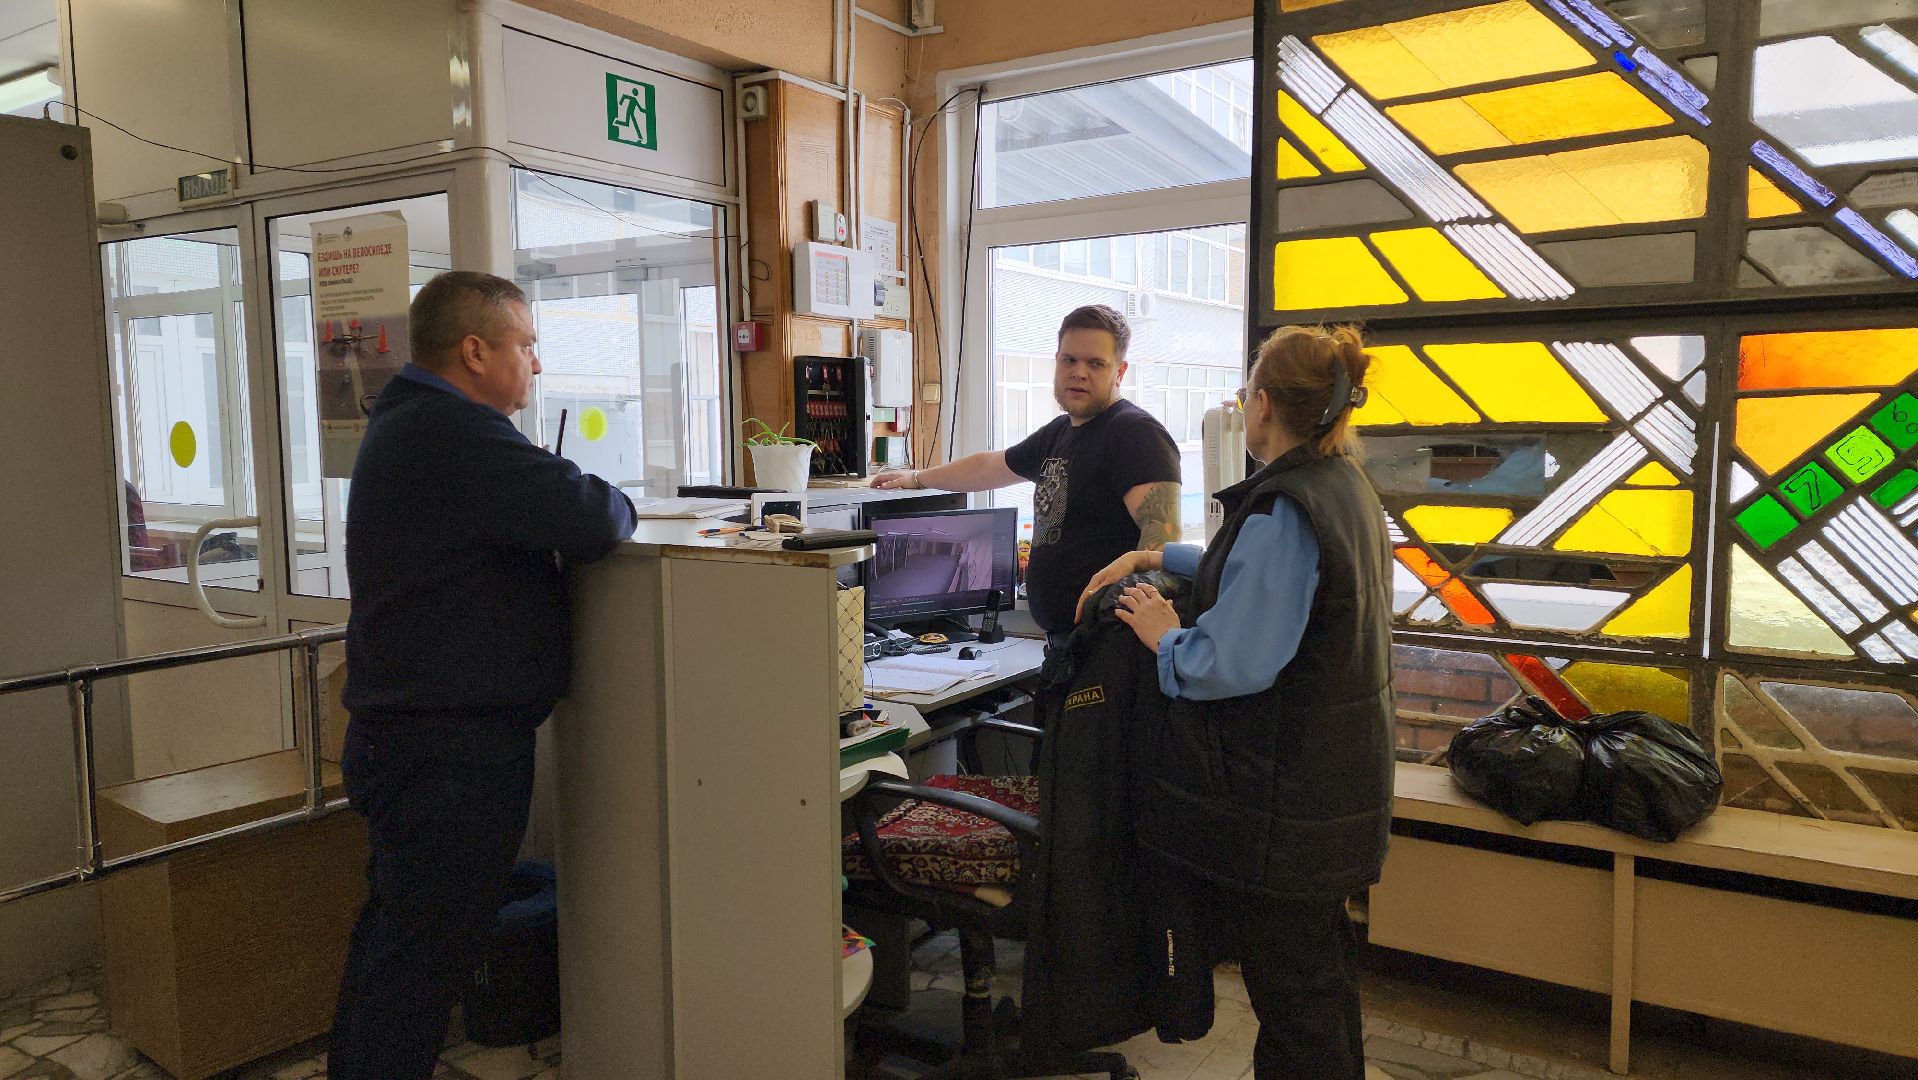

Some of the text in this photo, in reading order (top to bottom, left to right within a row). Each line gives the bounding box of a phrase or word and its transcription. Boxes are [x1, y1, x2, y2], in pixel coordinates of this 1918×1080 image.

[183, 173, 226, 199] ВЫХОД
[317, 243, 392, 263] ЕЗДИШЬ НА ВЕЛОСИПЕДЕ
[318, 267, 331, 278] ИЛИ
[1784, 469, 1822, 512] 7
